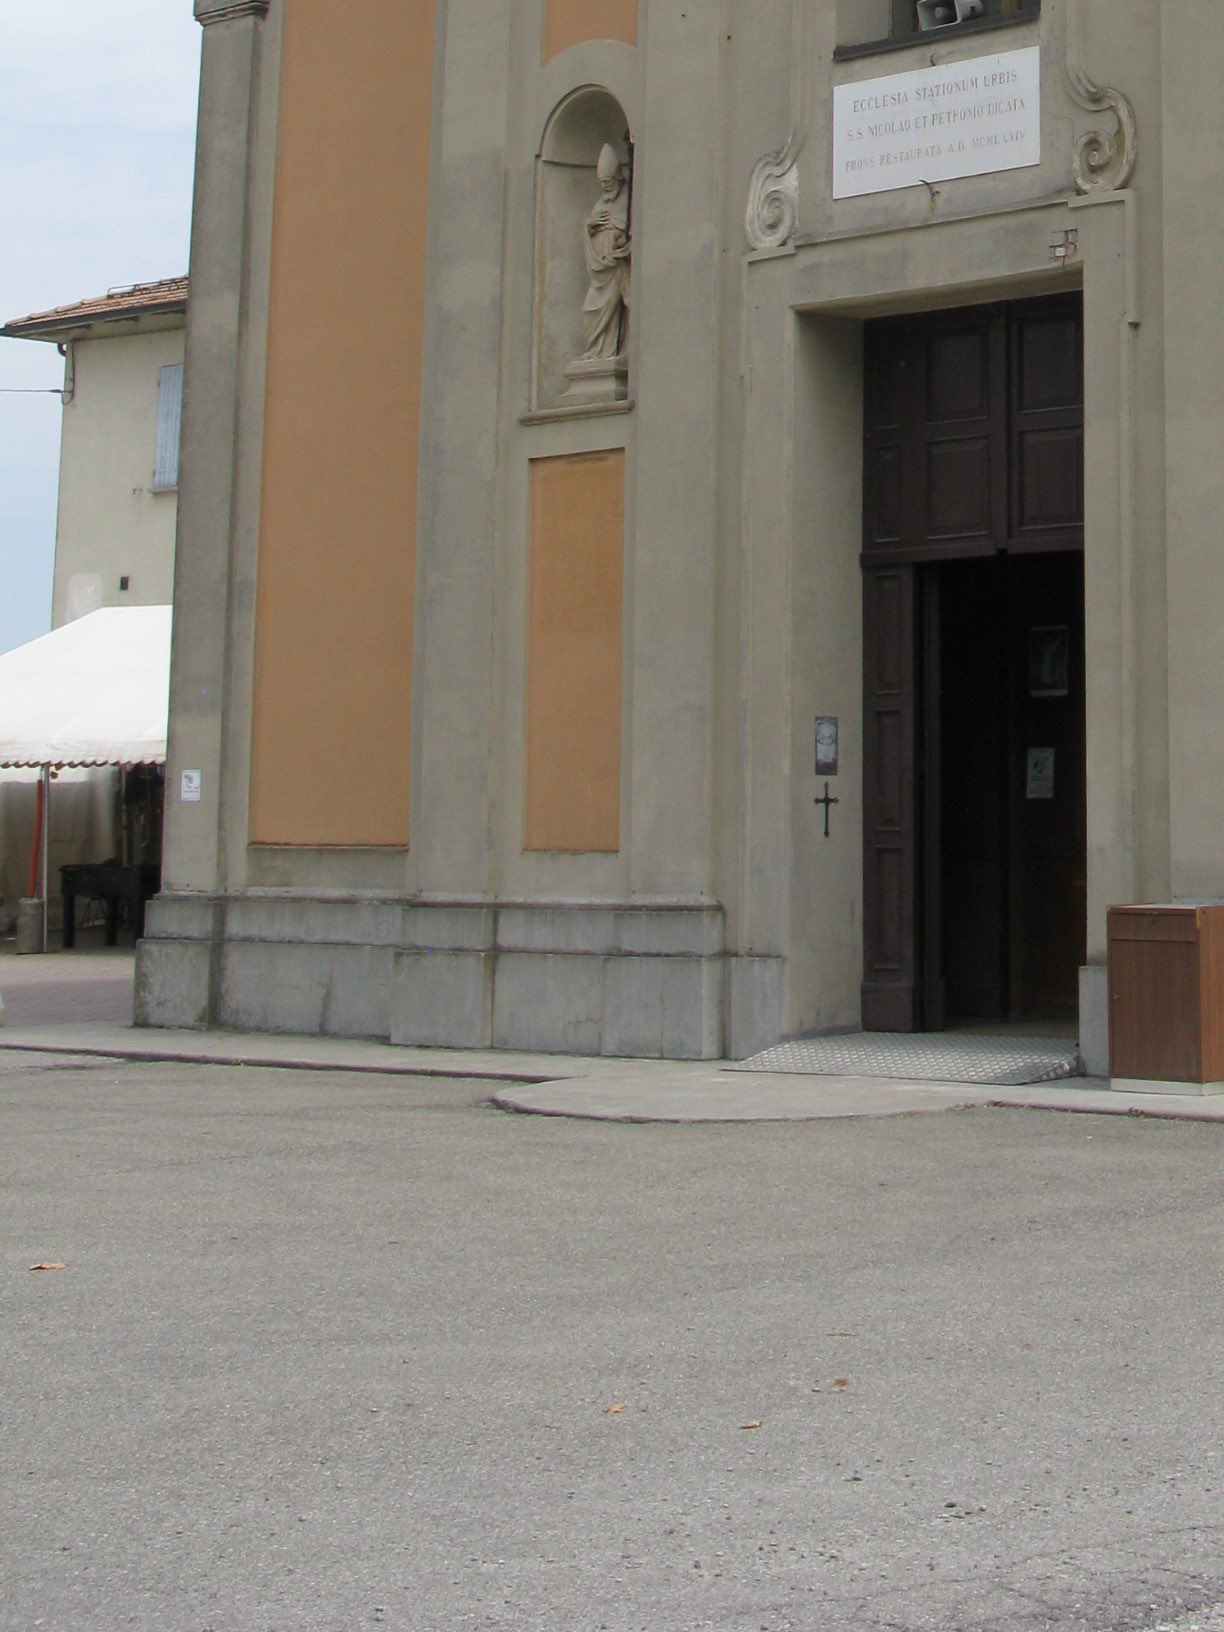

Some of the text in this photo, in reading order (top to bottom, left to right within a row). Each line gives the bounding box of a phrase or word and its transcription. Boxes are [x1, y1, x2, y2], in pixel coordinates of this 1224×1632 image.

[853, 70, 1018, 113] ECCLESIA STATIONUM URBIS
[868, 119, 911, 137] NICOLAO
[914, 115, 929, 130] ET
[931, 106, 984, 127] PETRONIO
[988, 99, 1026, 120] DICATA
